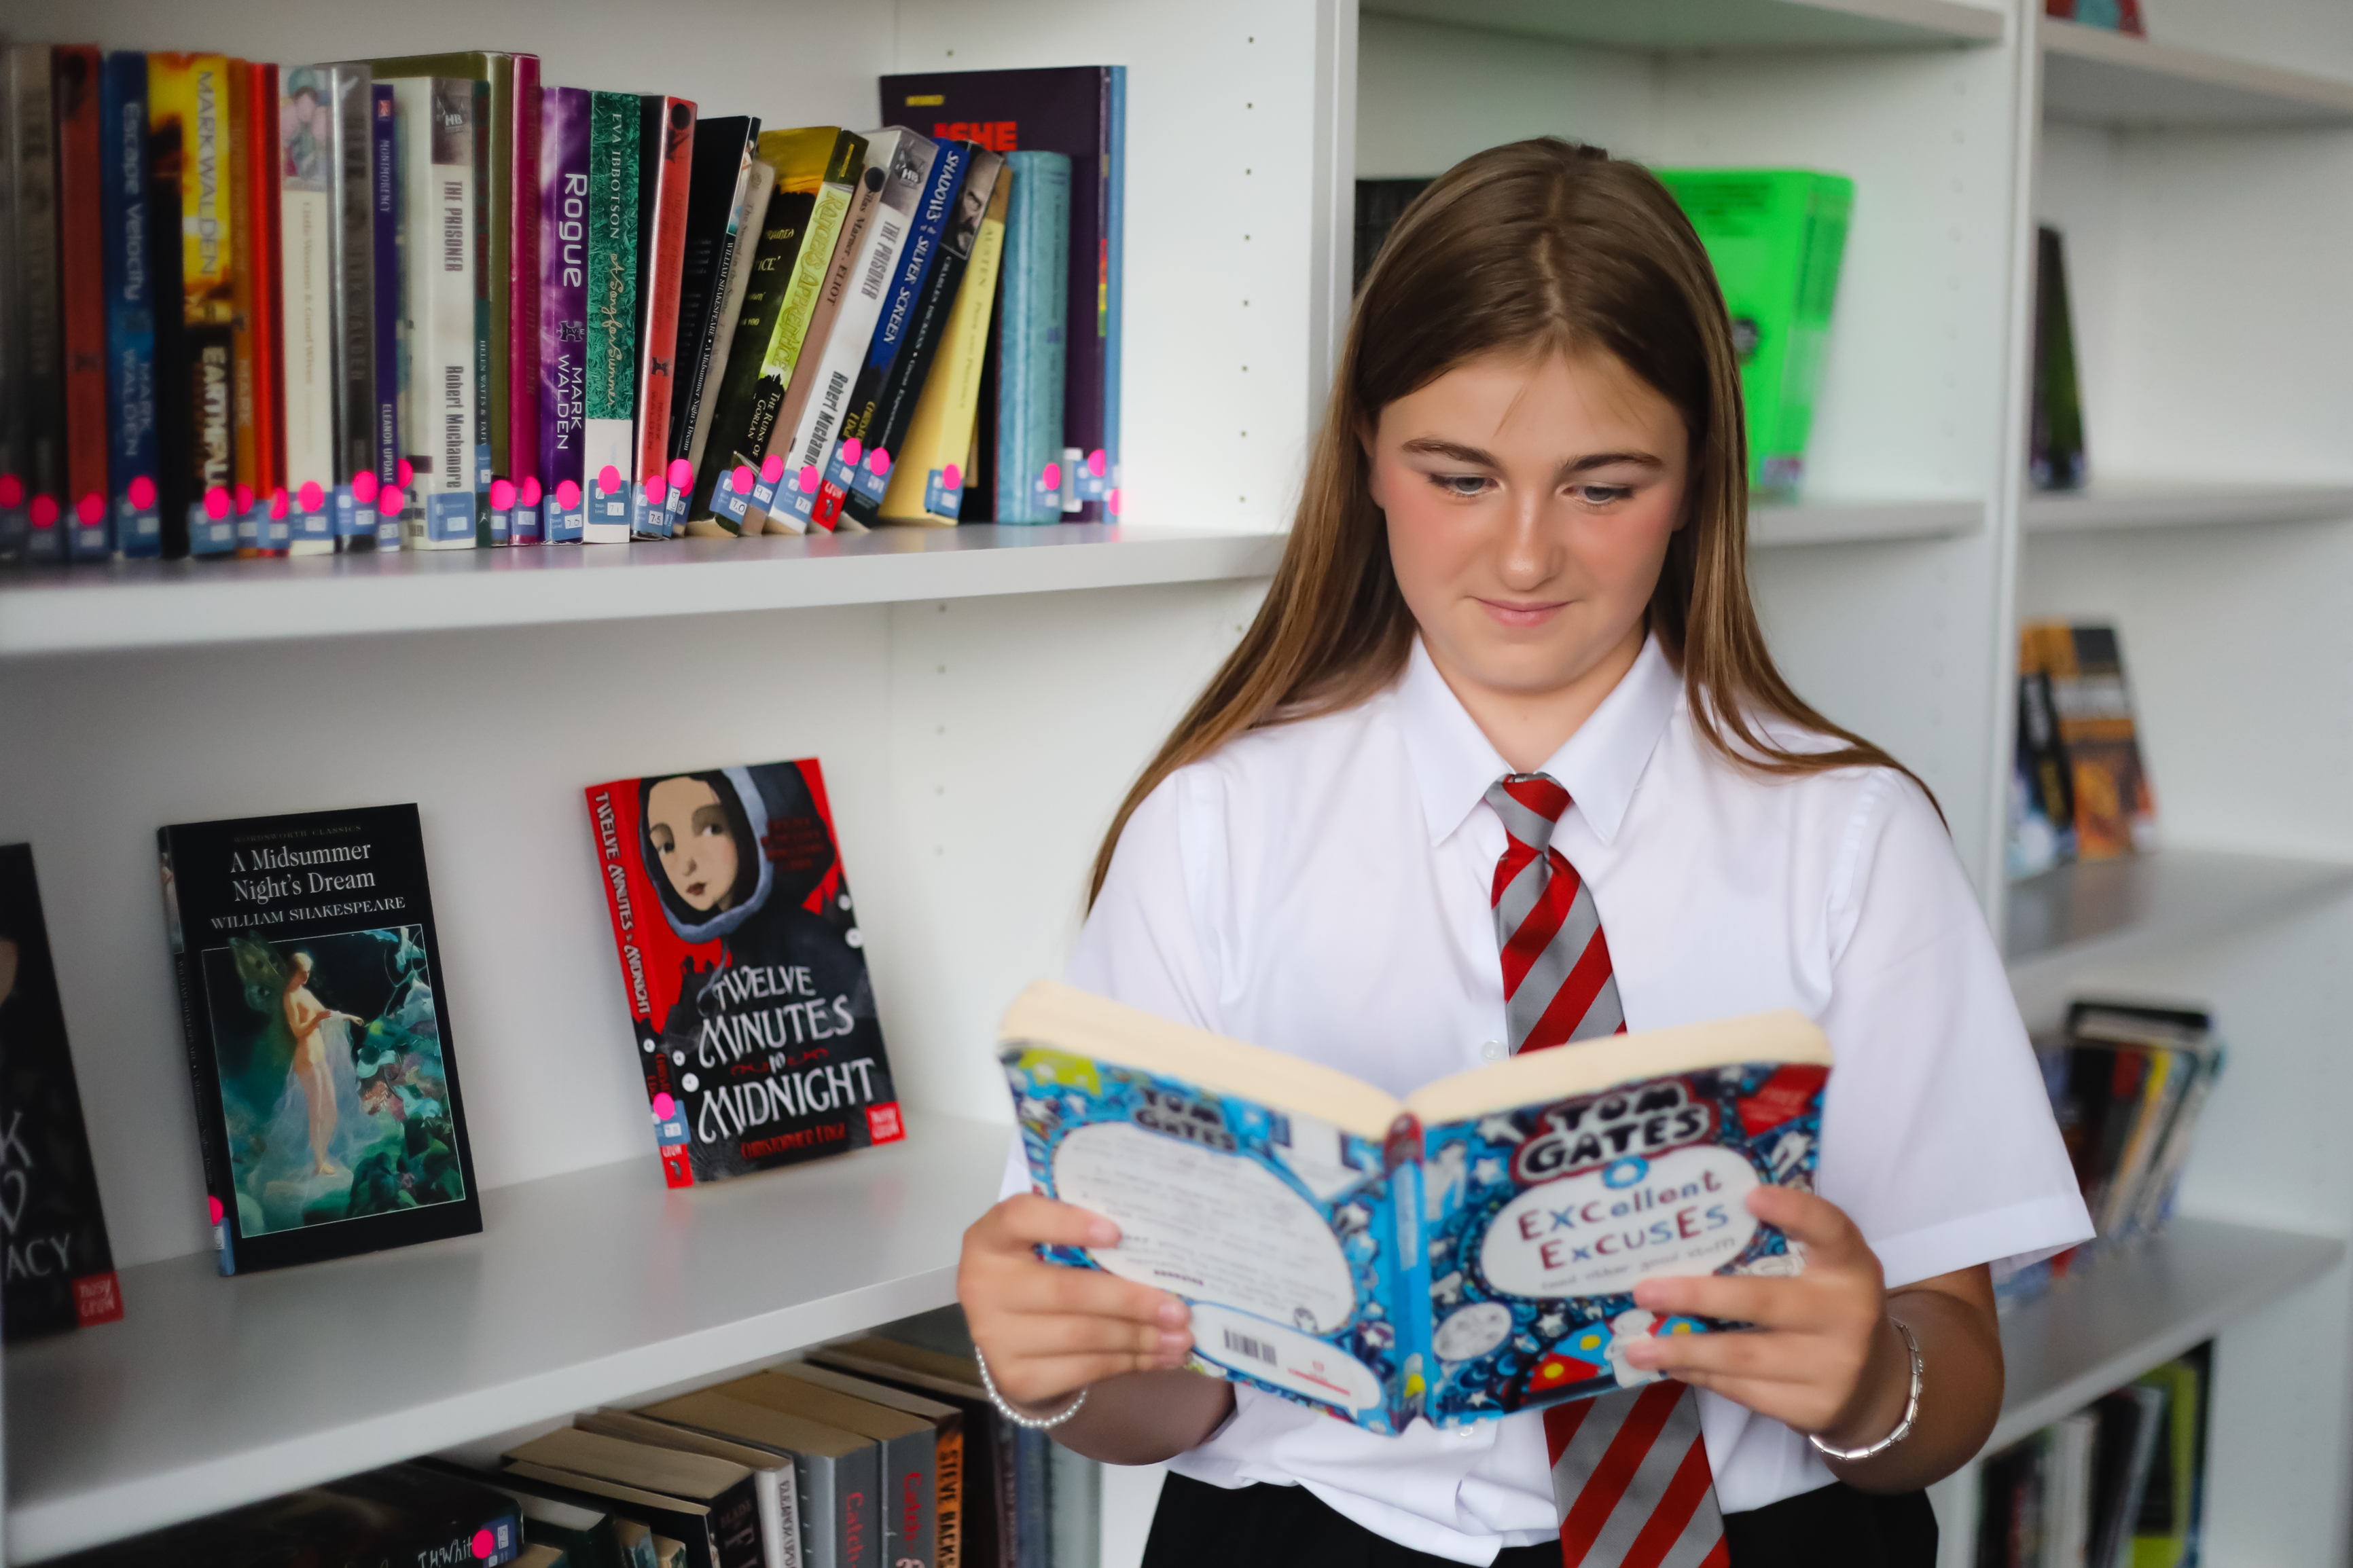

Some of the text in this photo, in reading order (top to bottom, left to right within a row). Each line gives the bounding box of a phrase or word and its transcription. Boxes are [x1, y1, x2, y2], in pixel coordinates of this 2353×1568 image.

[123, 102, 143, 300] Escape Velocity
[198, 71, 218, 275] MARK WALDEN
[380, 139, 391, 213] MONTMORENCY
[610, 113, 622, 239] EVA IBBOTSON
[926, 150, 960, 221] SHADOWS
[444, 181, 463, 272] THE PRISONER
[559, 173, 588, 287] Rogue
[842, 215, 865, 258] Marner
[720, 242, 734, 277] WILLIAM
[825, 263, 848, 307] ELIOT
[859, 220, 901, 300] THE PRISONER
[904, 236, 930, 284] SILVER
[930, 255, 953, 304] CHARLES
[977, 230, 993, 287] AUSTEN
[601, 253, 624, 407] A Song for Summer
[706, 278, 726, 337] SHAKESPEARE
[883, 286, 912, 344] SCREEN
[914, 305, 935, 350] DICKENS
[123, 348, 139, 456] WALDEN
[139, 362, 153, 433] MARK
[556, 354, 570, 448] WALDEN
[571, 367, 583, 430] MARK
[694, 352, 710, 397] Midsummer
[821, 370, 849, 412] Robert
[446, 366, 465, 488] Robert Muchamore
[647, 390, 658, 450] WALDEN
[654, 401, 664, 441] MARK
[683, 426, 694, 450] Dream
[687, 399, 700, 424] Night's
[747, 399, 767, 439] GORLAN
[751, 391, 780, 457] THE RUINS OF
[382, 404, 393, 483] ELEANOR UPDALE
[312, 824, 361, 838] CLASSICS
[595, 791, 622, 860] TWELVE
[230, 842, 372, 873] A Midsummer
[234, 870, 376, 904] Night's Dream
[211, 897, 406, 930] WILLIAM SHAKESPEARE
[607, 863, 634, 931] MINUTES
[623, 944, 651, 1015] MIDNIGHT
[713, 966, 816, 1012] TWELVE
[698, 995, 855, 1069] MINUTES
[698, 1057, 876, 1144] MIDNIGHT
[1550, 1082, 1685, 1134] TOM
[1519, 1104, 1709, 1180] GATES
[936, 1449, 959, 1500] STEVE
